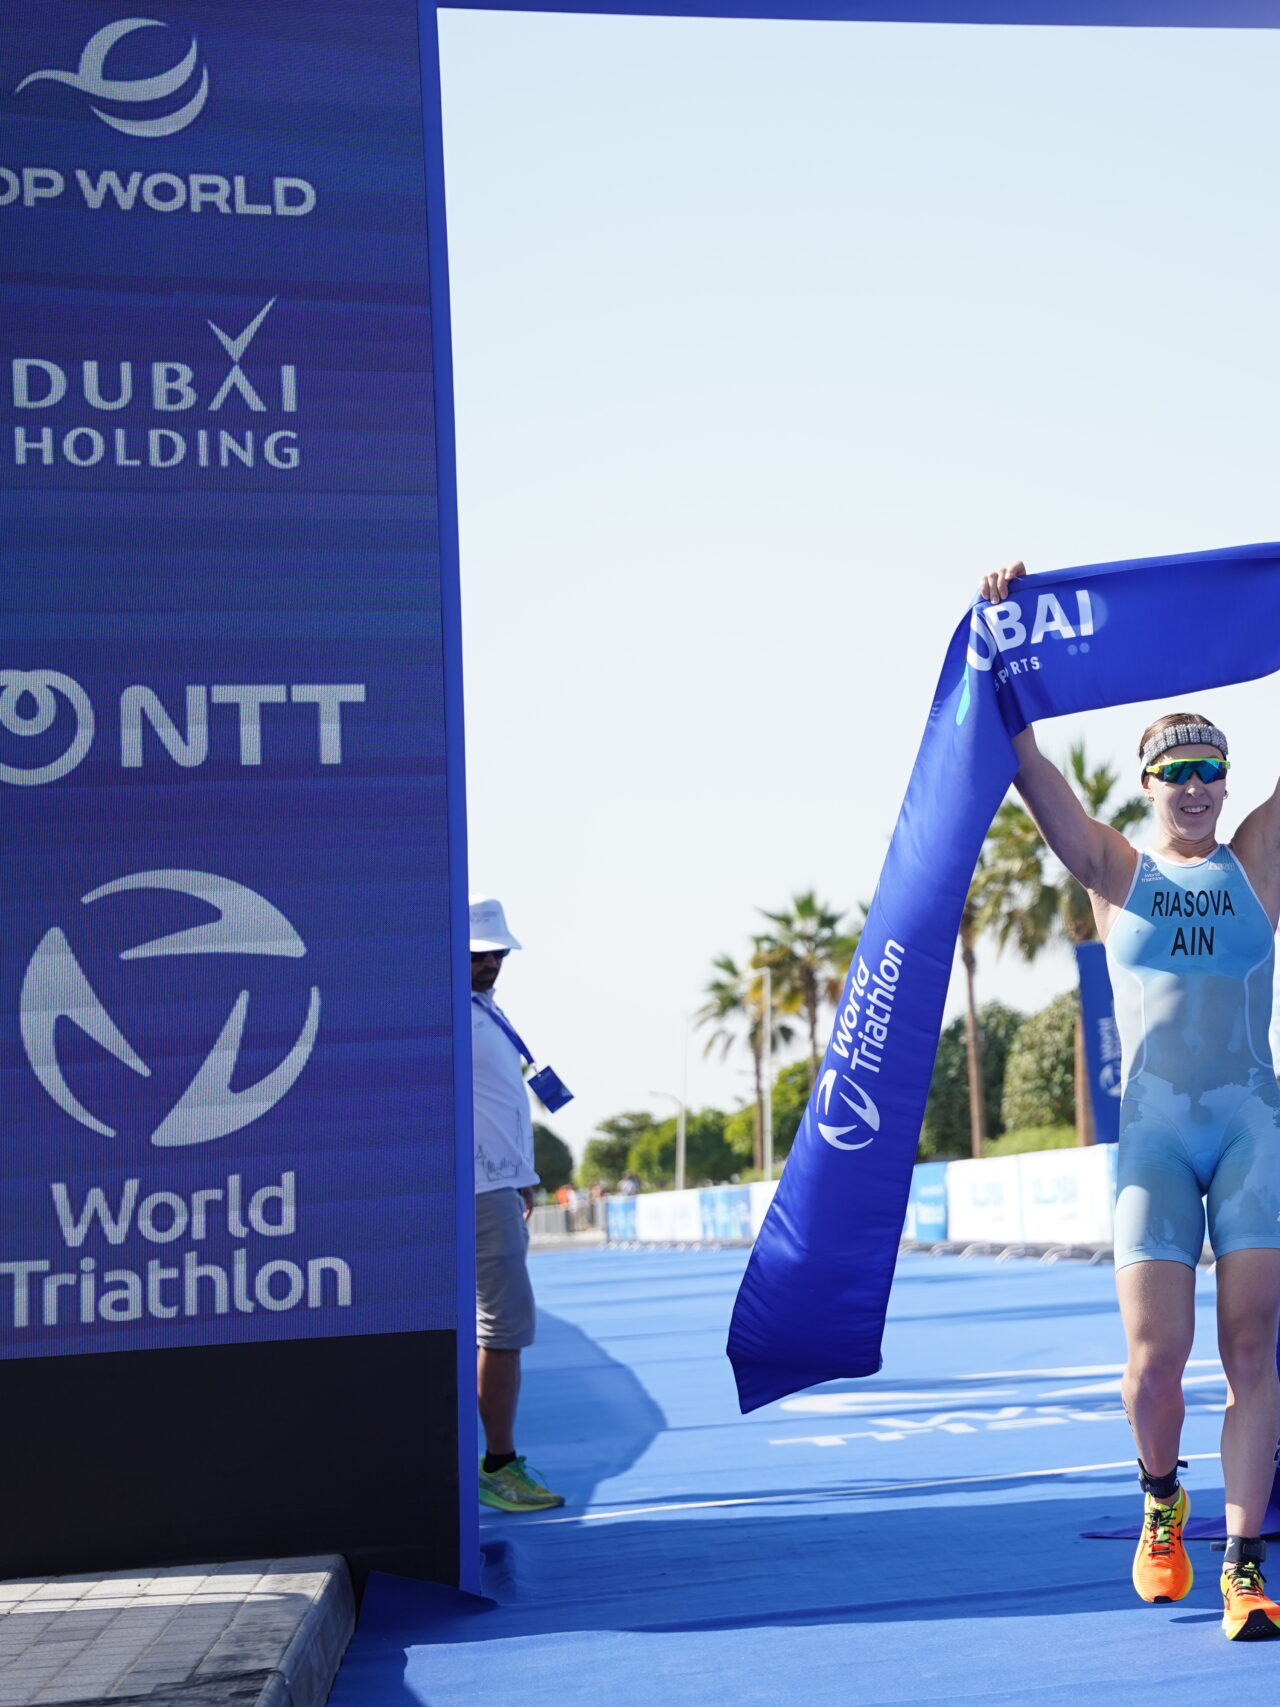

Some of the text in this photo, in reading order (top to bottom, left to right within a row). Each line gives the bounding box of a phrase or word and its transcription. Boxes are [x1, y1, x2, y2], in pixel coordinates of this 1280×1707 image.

[75, 169, 317, 216] WORLD
[14, 427, 301, 470] HOLDING
[120, 684, 366, 768] NTT
[1151, 889, 1236, 918] RIASOVA
[1170, 926, 1214, 956] AIN
[832, 955, 869, 1059] World
[850, 939, 905, 1073] Triathlon
[51, 1170, 297, 1248] World
[0, 1247, 352, 1328] Triathlon
